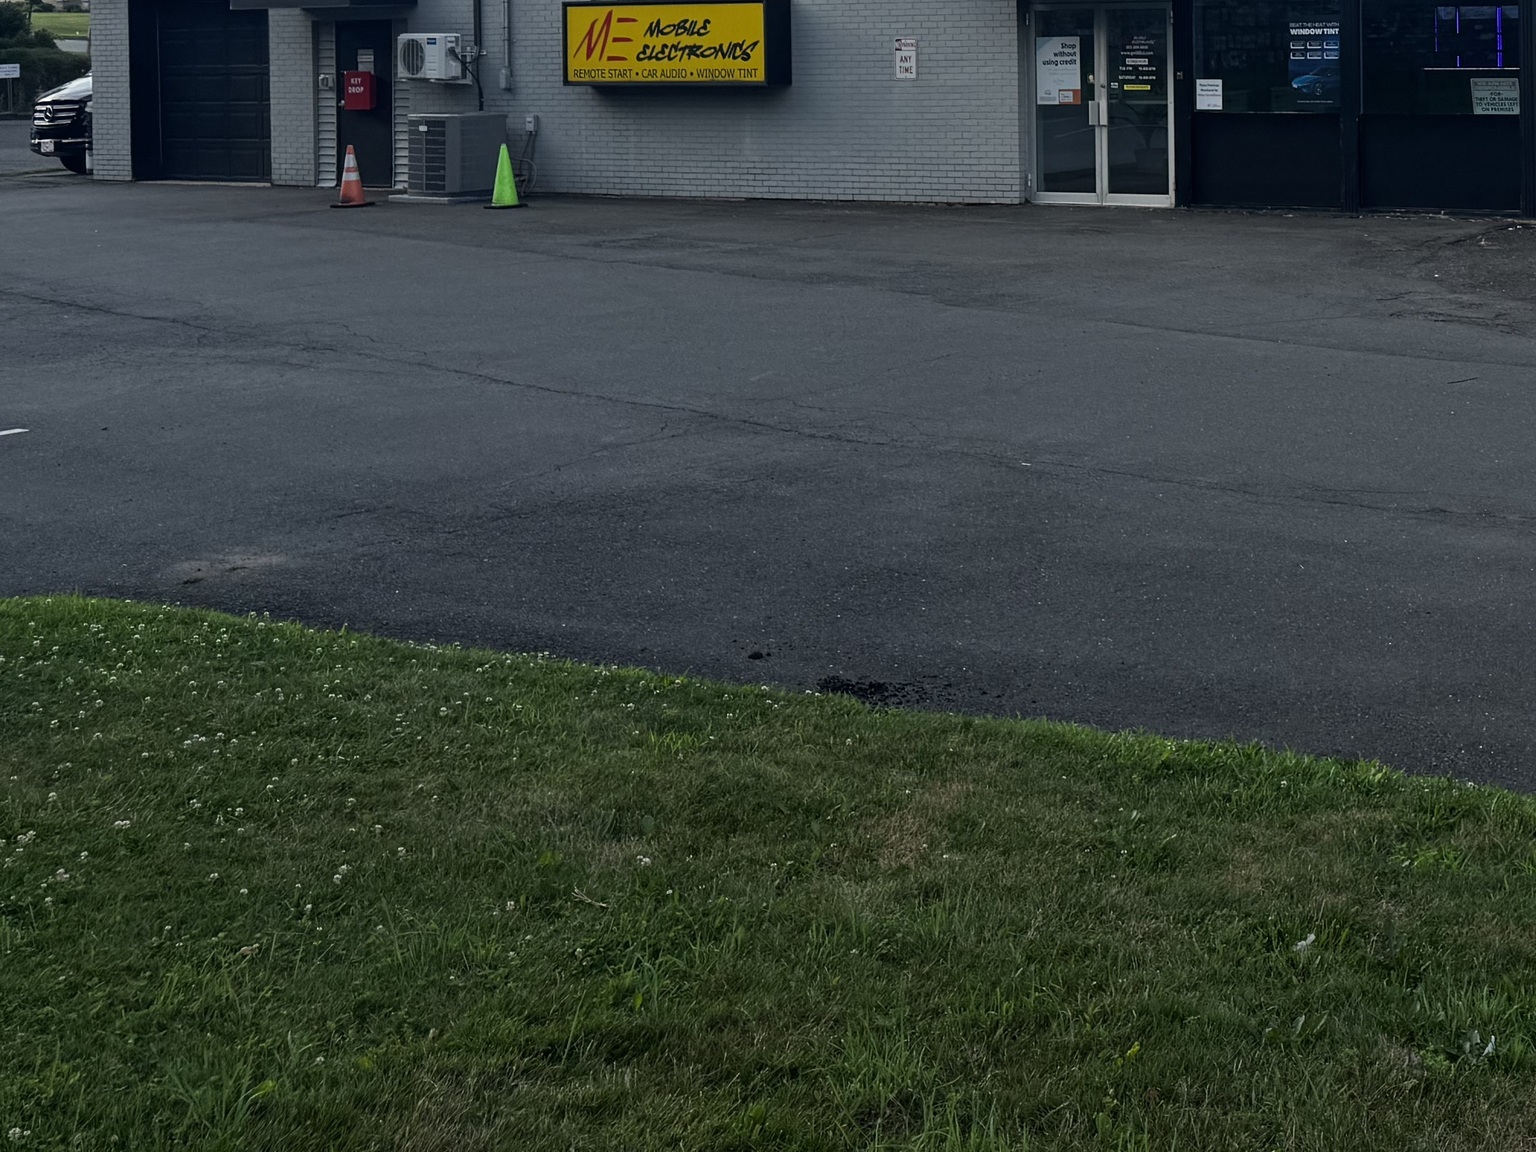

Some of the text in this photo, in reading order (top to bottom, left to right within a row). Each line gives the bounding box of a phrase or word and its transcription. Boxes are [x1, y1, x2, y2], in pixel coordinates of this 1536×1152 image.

[573, 9, 638, 62] ME
[643, 18, 711, 38] MOBILE
[636, 39, 760, 62] ELECTRONICS
[900, 55, 912, 63] ANY
[573, 68, 758, 79] REMOTE START CAR AUDIO WINDOW TINT
[899, 66, 913, 74] TIME
